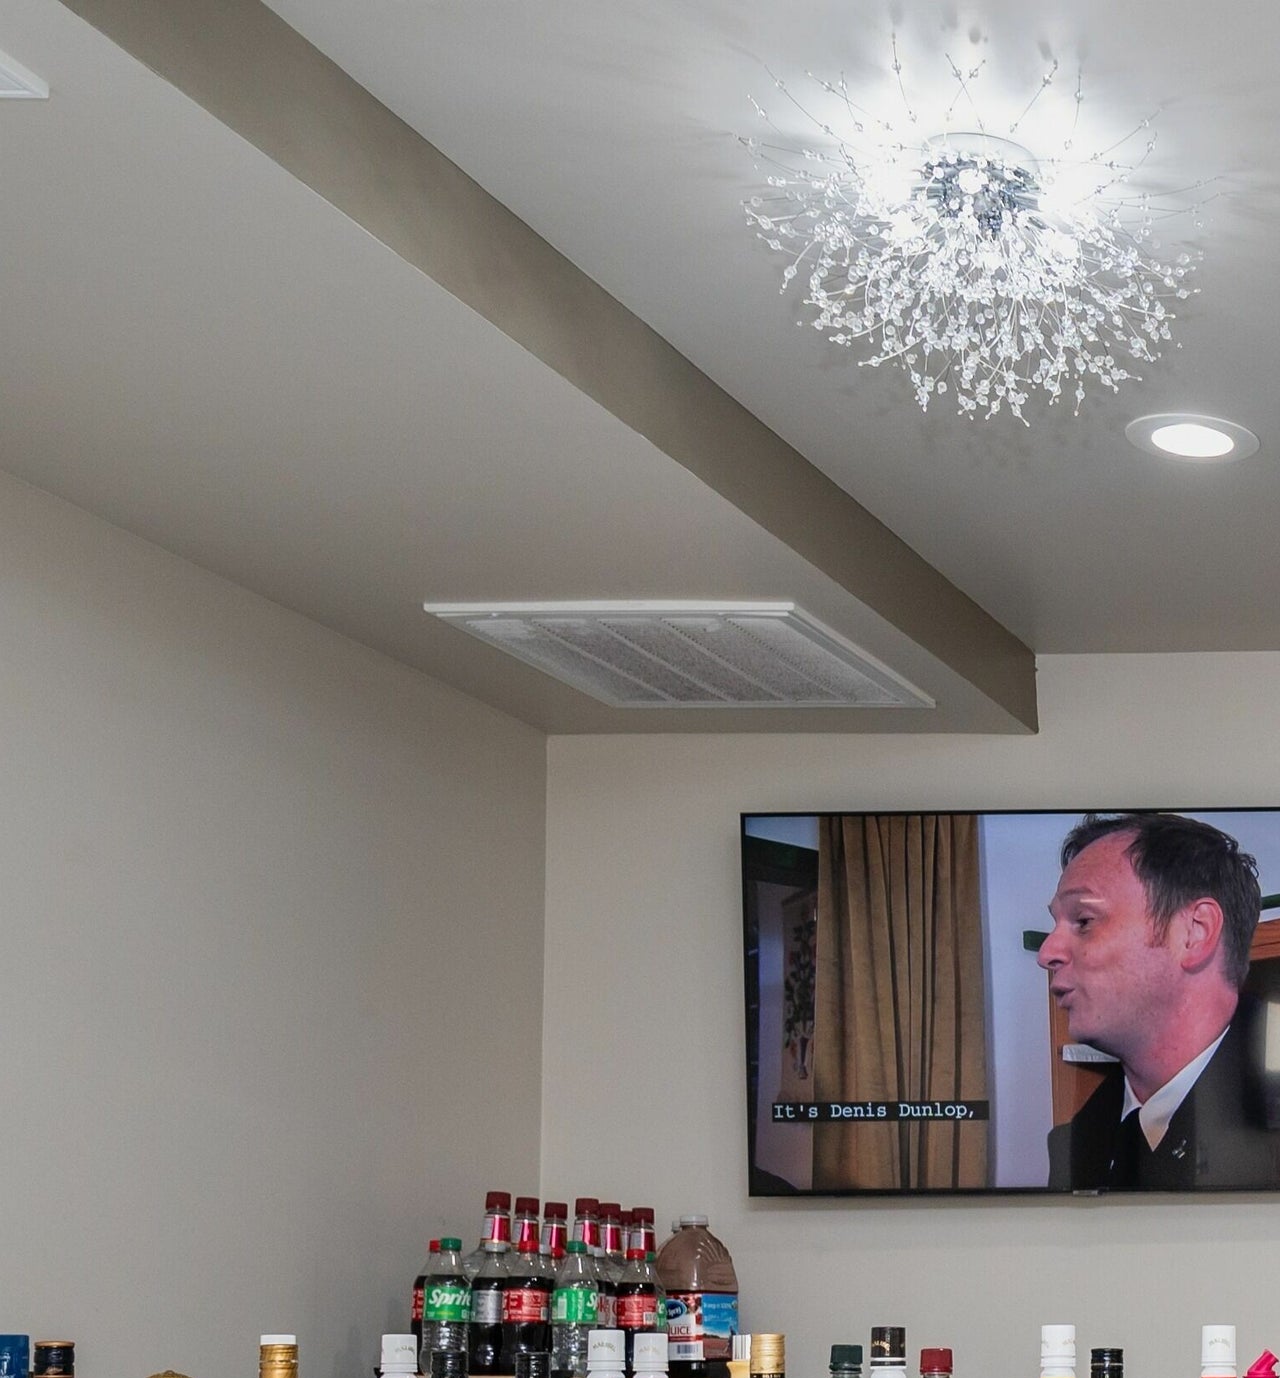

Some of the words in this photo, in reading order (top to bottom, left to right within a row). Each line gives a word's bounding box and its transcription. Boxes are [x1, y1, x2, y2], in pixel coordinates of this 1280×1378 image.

[773, 1104, 819, 1119] It's
[830, 1102, 887, 1118] Denis
[899, 1101, 975, 1119] Dunlop,
